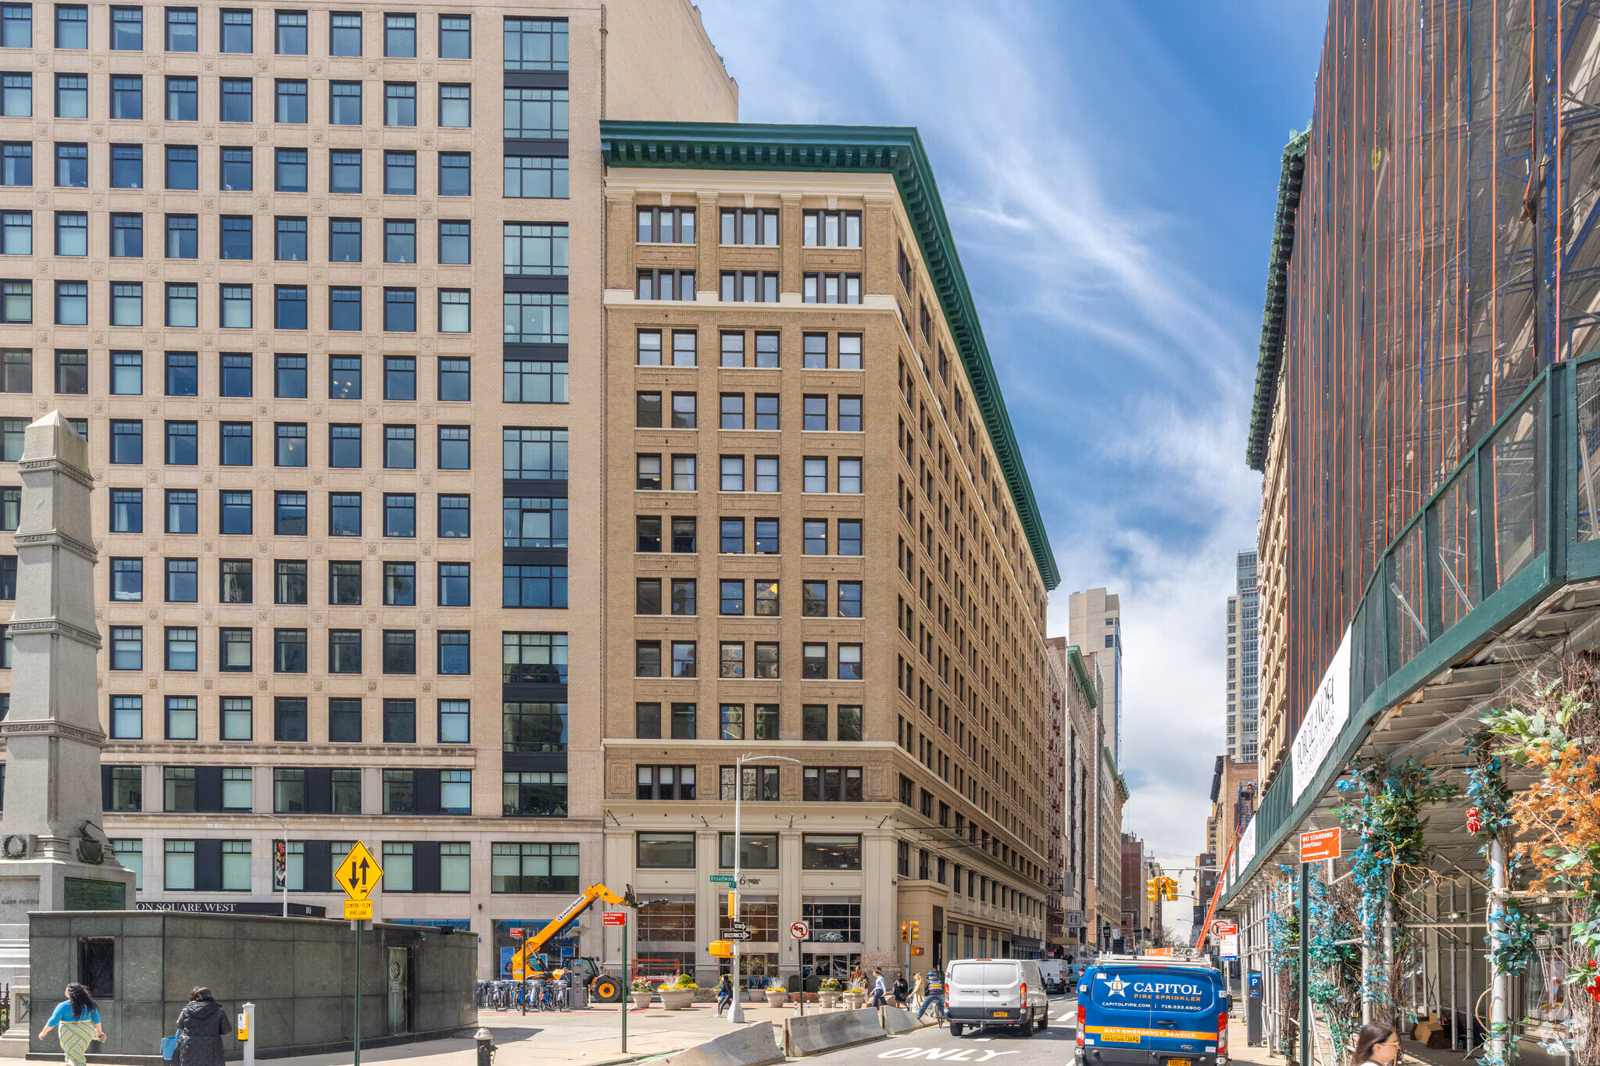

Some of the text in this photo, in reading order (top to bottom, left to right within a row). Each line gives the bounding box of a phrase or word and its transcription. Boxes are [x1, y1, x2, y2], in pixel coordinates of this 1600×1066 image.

[136, 902, 237, 912] ON SQUARE WEST
[1069, 914, 1078, 923] H
[1252, 978, 1258, 986] P
[1133, 982, 1202, 995] CAPITOL
[1155, 994, 1201, 1002] SPRINKLER
[1121, 1029, 1164, 1037] EMERGENCY
[878, 1047, 1021, 1061] ONLY
